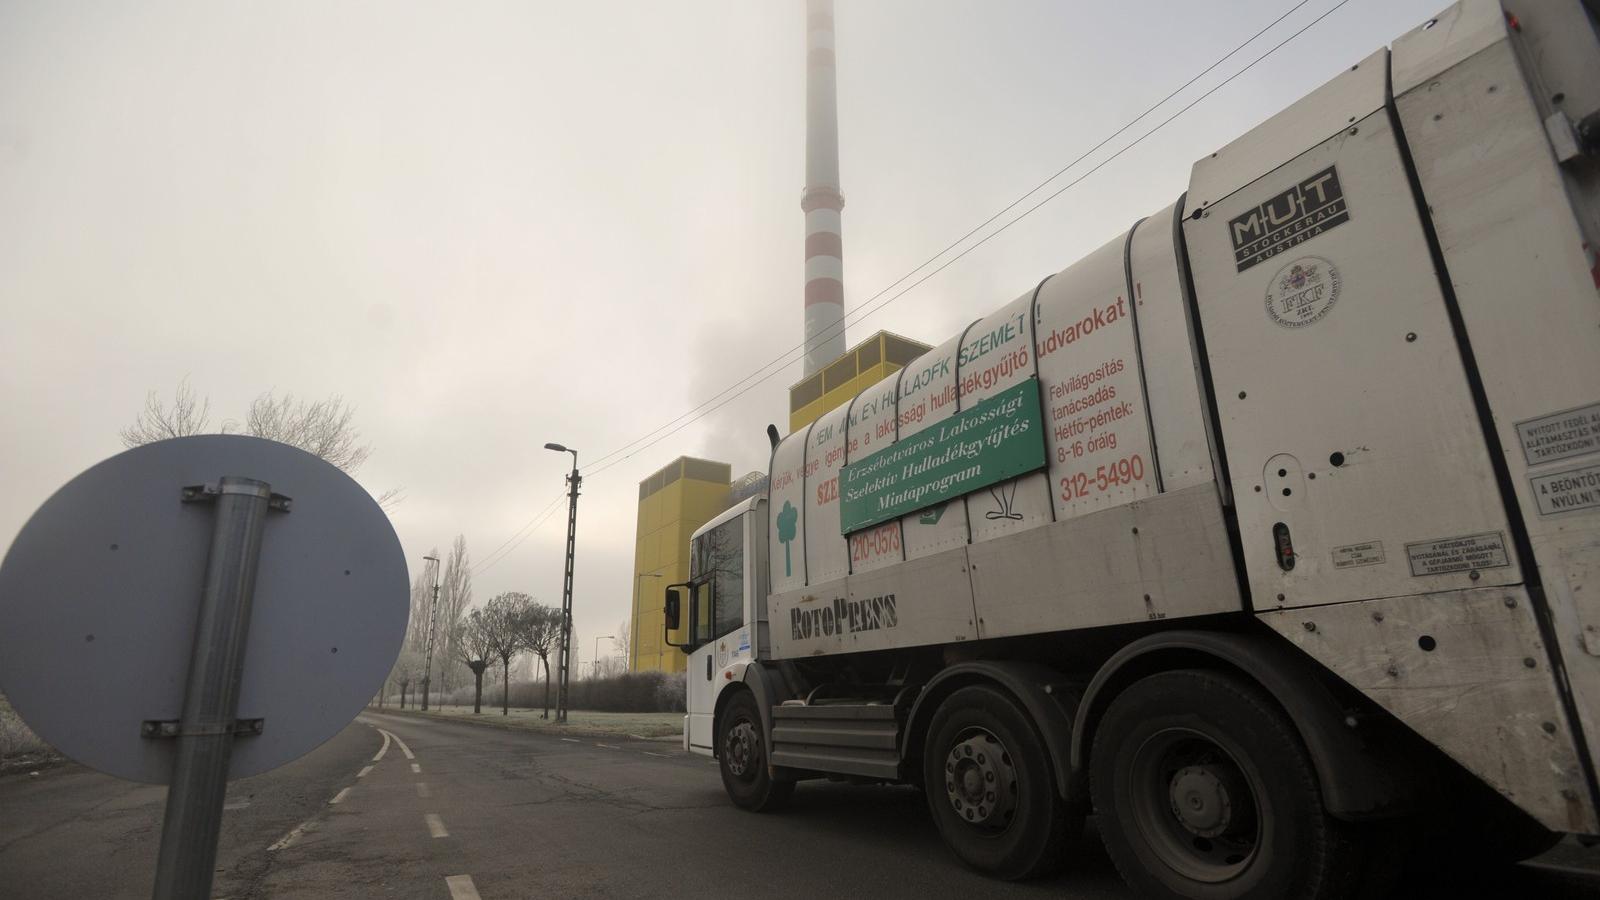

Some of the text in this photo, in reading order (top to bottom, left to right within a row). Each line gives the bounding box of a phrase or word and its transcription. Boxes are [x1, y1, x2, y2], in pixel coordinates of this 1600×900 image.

[1243, 205, 1337, 257] STOCKERAU
[1255, 226, 1323, 264] AUSTRIA
[1280, 283, 1325, 314] FKF
[864, 432, 870, 446] a
[875, 402, 926, 441] lakossági
[930, 345, 1028, 412] hulladékgyűjtő
[1037, 296, 1126, 359] udvarokat
[1049, 358, 1124, 401] Felvilágosítás
[1052, 384, 1116, 421] tanácsadás
[848, 390, 1024, 482] Erzsébetváros Lakossági
[1057, 431, 1117, 463] 8-16 óráig
[845, 418, 1030, 503] Szelektív Hulladékgyűjtés
[1060, 454, 1144, 501] 312-5490
[877, 464, 982, 512] Mintaprogram
[1541, 483, 1548, 495] A
[852, 525, 900, 561] 210-0573
